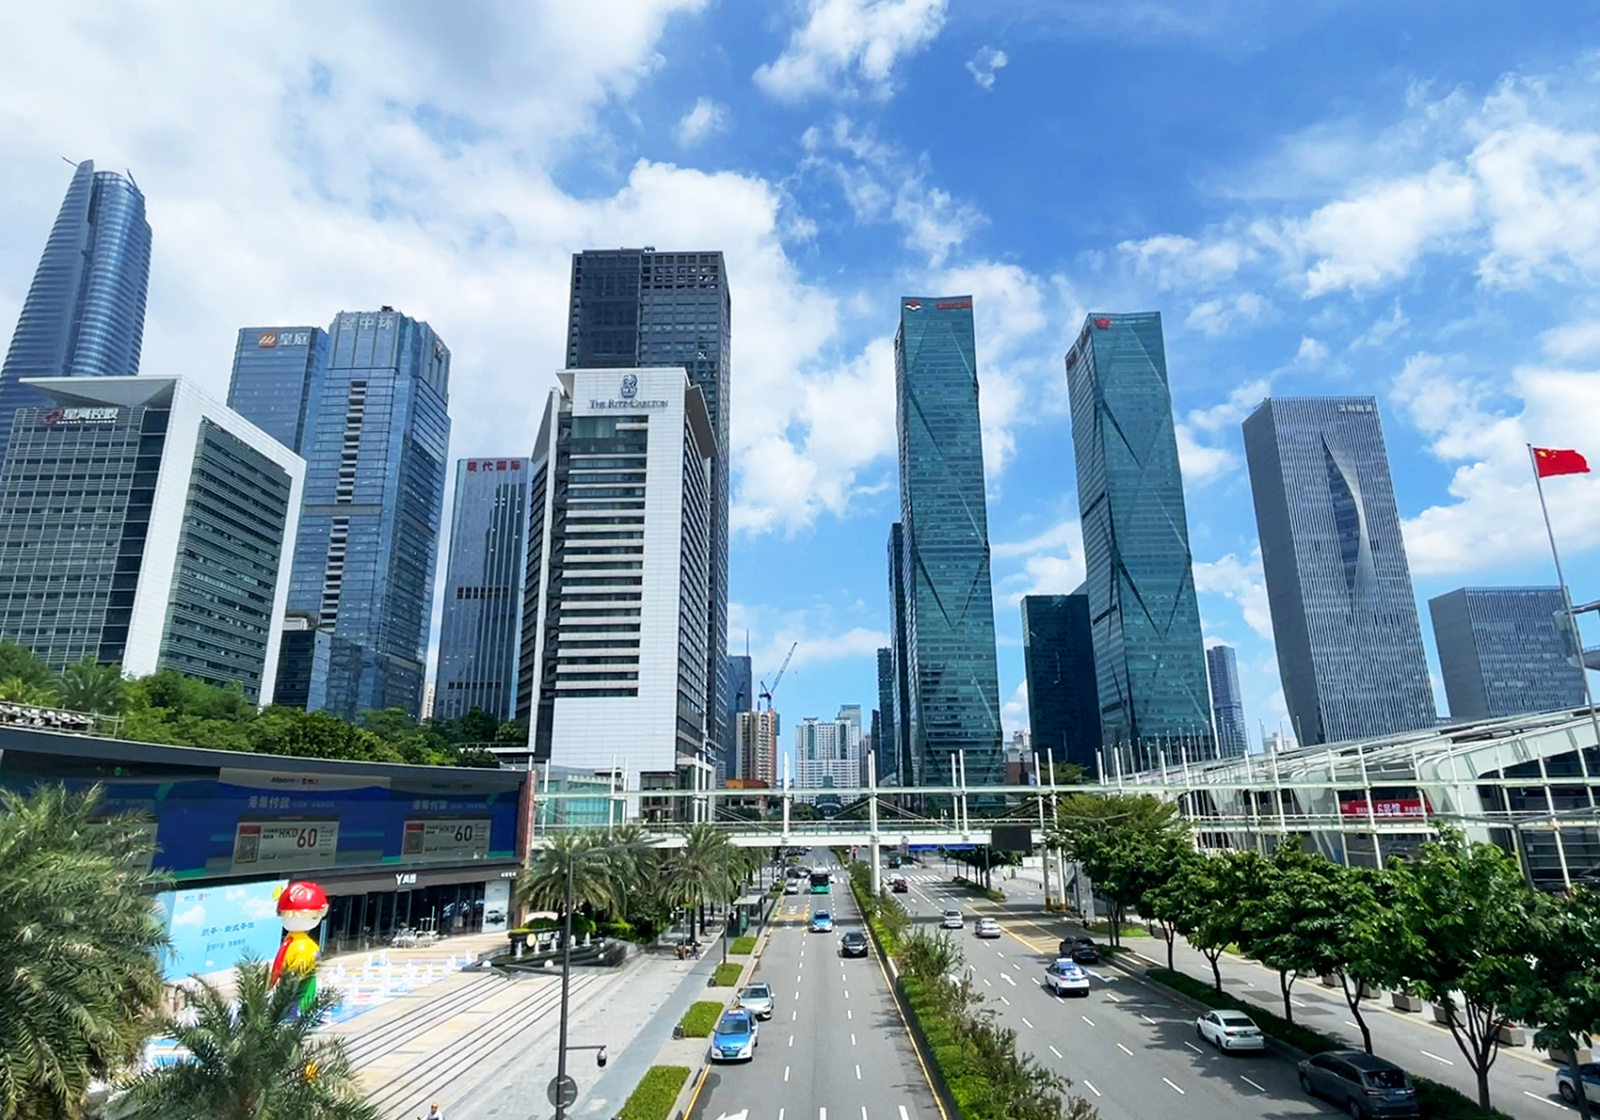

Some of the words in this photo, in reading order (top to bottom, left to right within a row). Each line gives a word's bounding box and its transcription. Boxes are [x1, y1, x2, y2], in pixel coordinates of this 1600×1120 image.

[279, 332, 309, 346] 皇庭
[589, 399, 606, 409] THE
[467, 461, 521, 472] 现代国际
